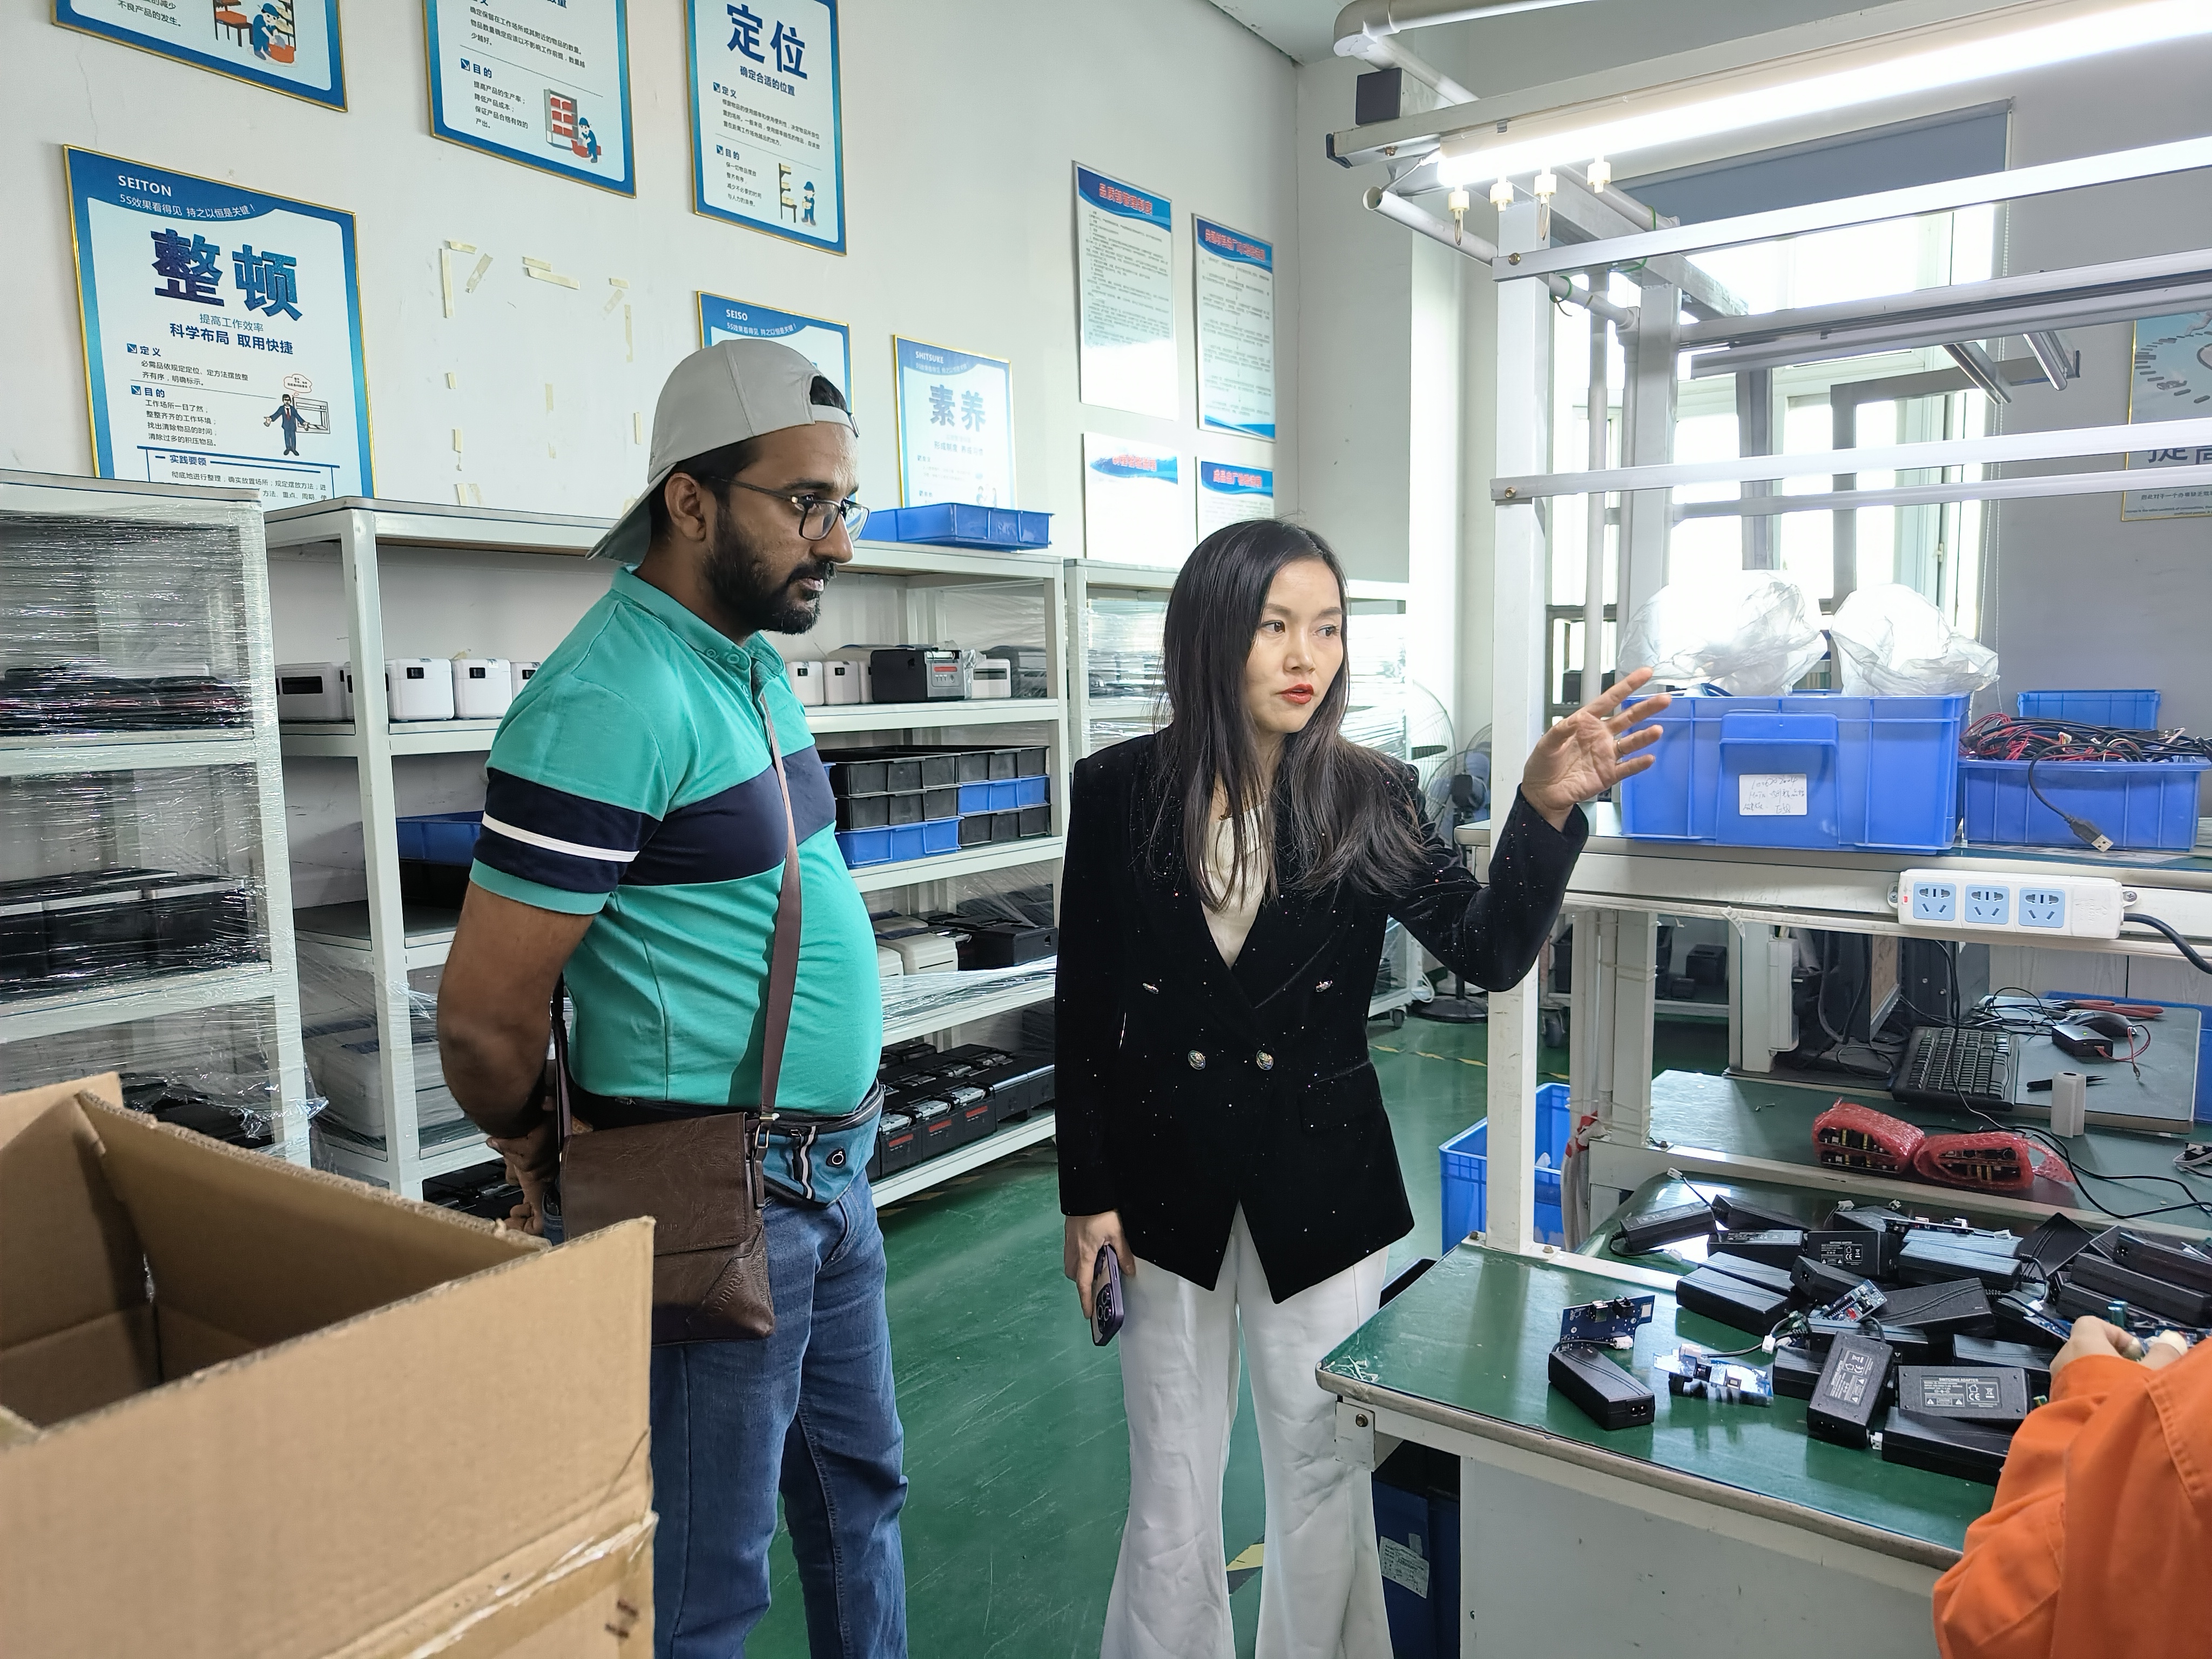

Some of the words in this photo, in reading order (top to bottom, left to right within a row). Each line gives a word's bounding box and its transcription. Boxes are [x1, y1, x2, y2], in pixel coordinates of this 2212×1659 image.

[471, 32, 492, 45] 少越好。
[726, 3, 808, 79] 定位
[473, 63, 492, 78] 目的
[740, 65, 795, 96] 确定合适的位置
[474, 80, 525, 104] 提高产品的生产率；
[722, 86, 737, 98] 定义
[474, 93, 514, 112] 降低产品成本；
[475, 105, 528, 129] 保证产品合格有效的
[475, 118, 491, 129] 产出。
[726, 148, 740, 160] 目的
[118, 175, 172, 197] SEITON
[119, 193, 183, 217] 5S效果看得见
[186, 204, 255, 218] 持之以恒是关键！
[150, 228, 303, 321] 整顿
[199, 313, 264, 333] 提高工作效率
[726, 309, 748, 321] SEISO
[170, 323, 230, 345] 科学布局
[237, 333, 293, 355] 取用快捷
[139, 345, 161, 357] 定义
[915, 351, 945, 365] SHITSUKE
[141, 360, 248, 381] 必需品依规定定位、定方法摆放整
[142, 371, 204, 386] 齐有序，明确标示。
[145, 387, 165, 398] 目的
[928, 384, 986, 433] 素养
[170, 454, 207, 466] 实践要领
[171, 471, 327, 491] 彻底地进行整理；确实放置场所；规定摆放方法；进
